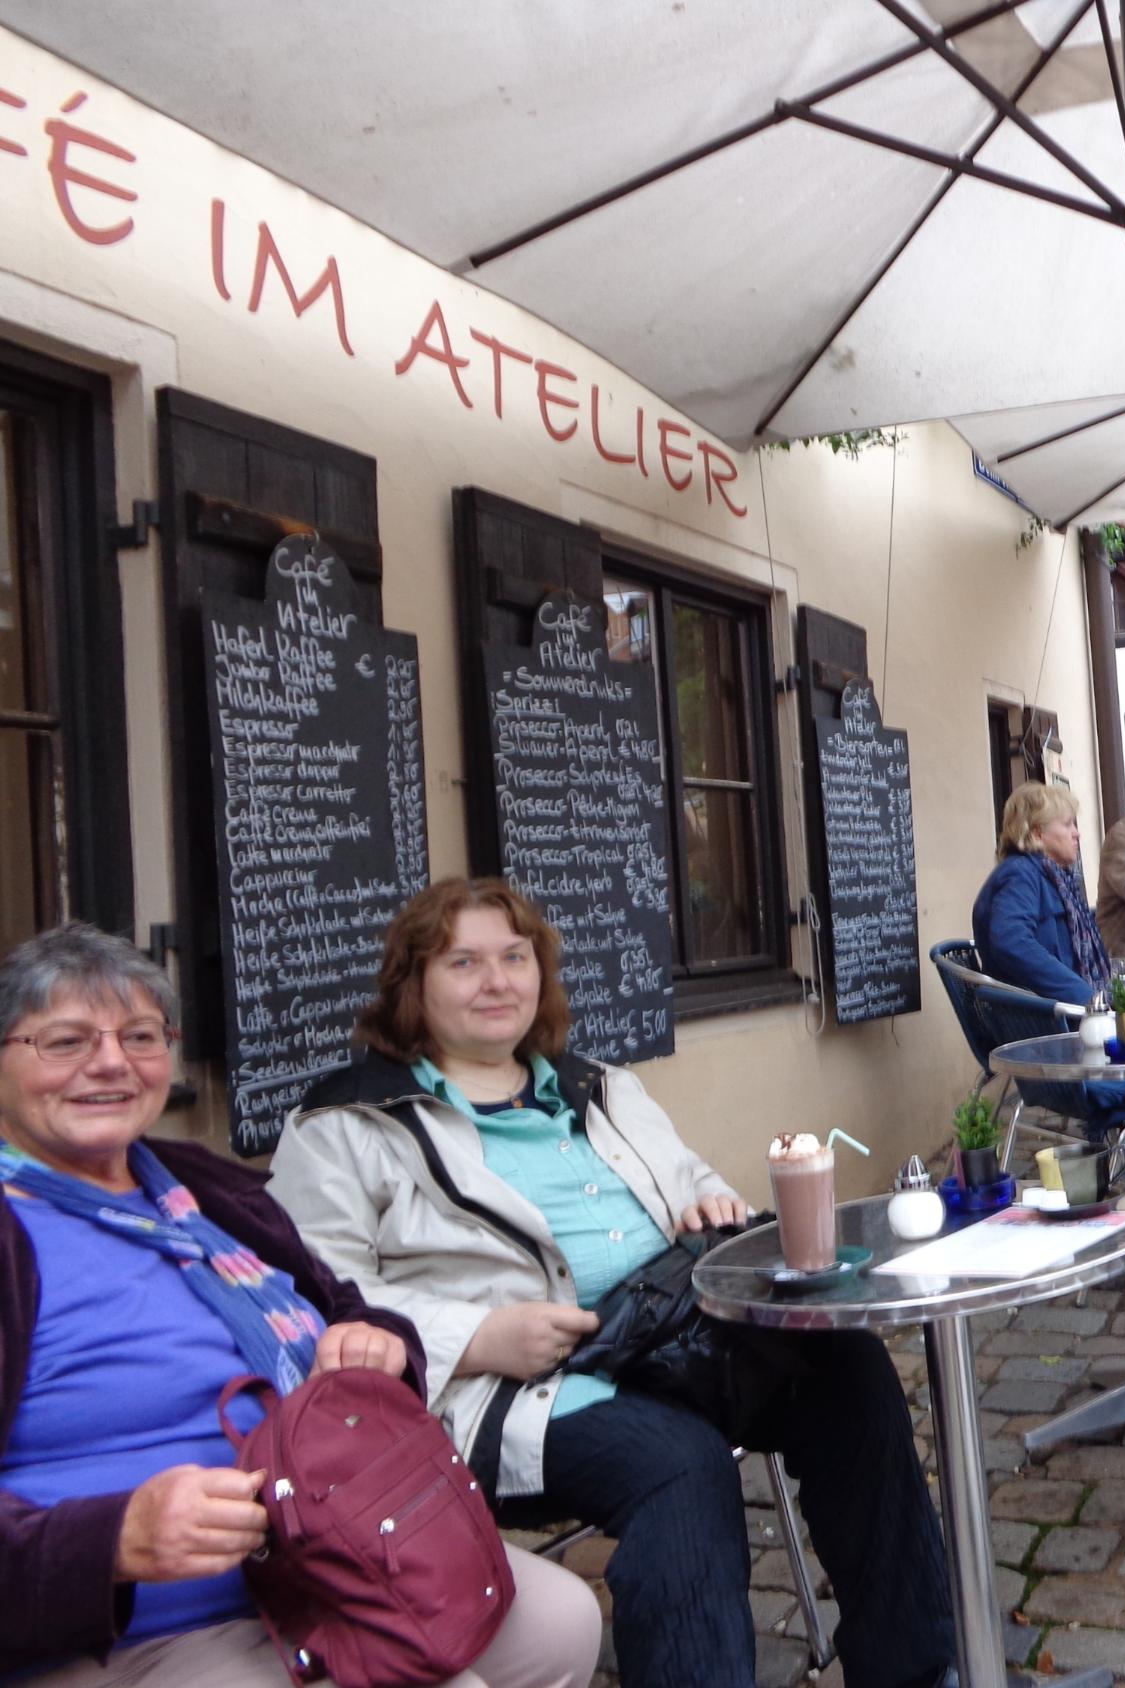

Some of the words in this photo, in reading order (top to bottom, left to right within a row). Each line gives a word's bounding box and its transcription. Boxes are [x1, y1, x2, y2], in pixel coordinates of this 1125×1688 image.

[211, 198, 356, 357] IM
[395, 300, 748, 518] ATELIER
[275, 547, 335, 586] Café
[278, 600, 358, 641] Atelier
[539, 602, 592, 632] Café
[275, 631, 337, 674] Kaffee
[354, 653, 376, 679] €
[540, 641, 602, 672] Atelier
[278, 660, 338, 695] Kaffee
[216, 679, 320, 720] Milchkaffee
[219, 709, 300, 742] Espresso
[222, 736, 298, 764] Espresso
[617, 740, 631, 759] €
[224, 758, 295, 784] Espresso
[224, 779, 296, 806] Espresso
[623, 858, 637, 878] €
[618, 973, 635, 998] €
[236, 1001, 279, 1035] Latte
[624, 1027, 639, 1049] €
